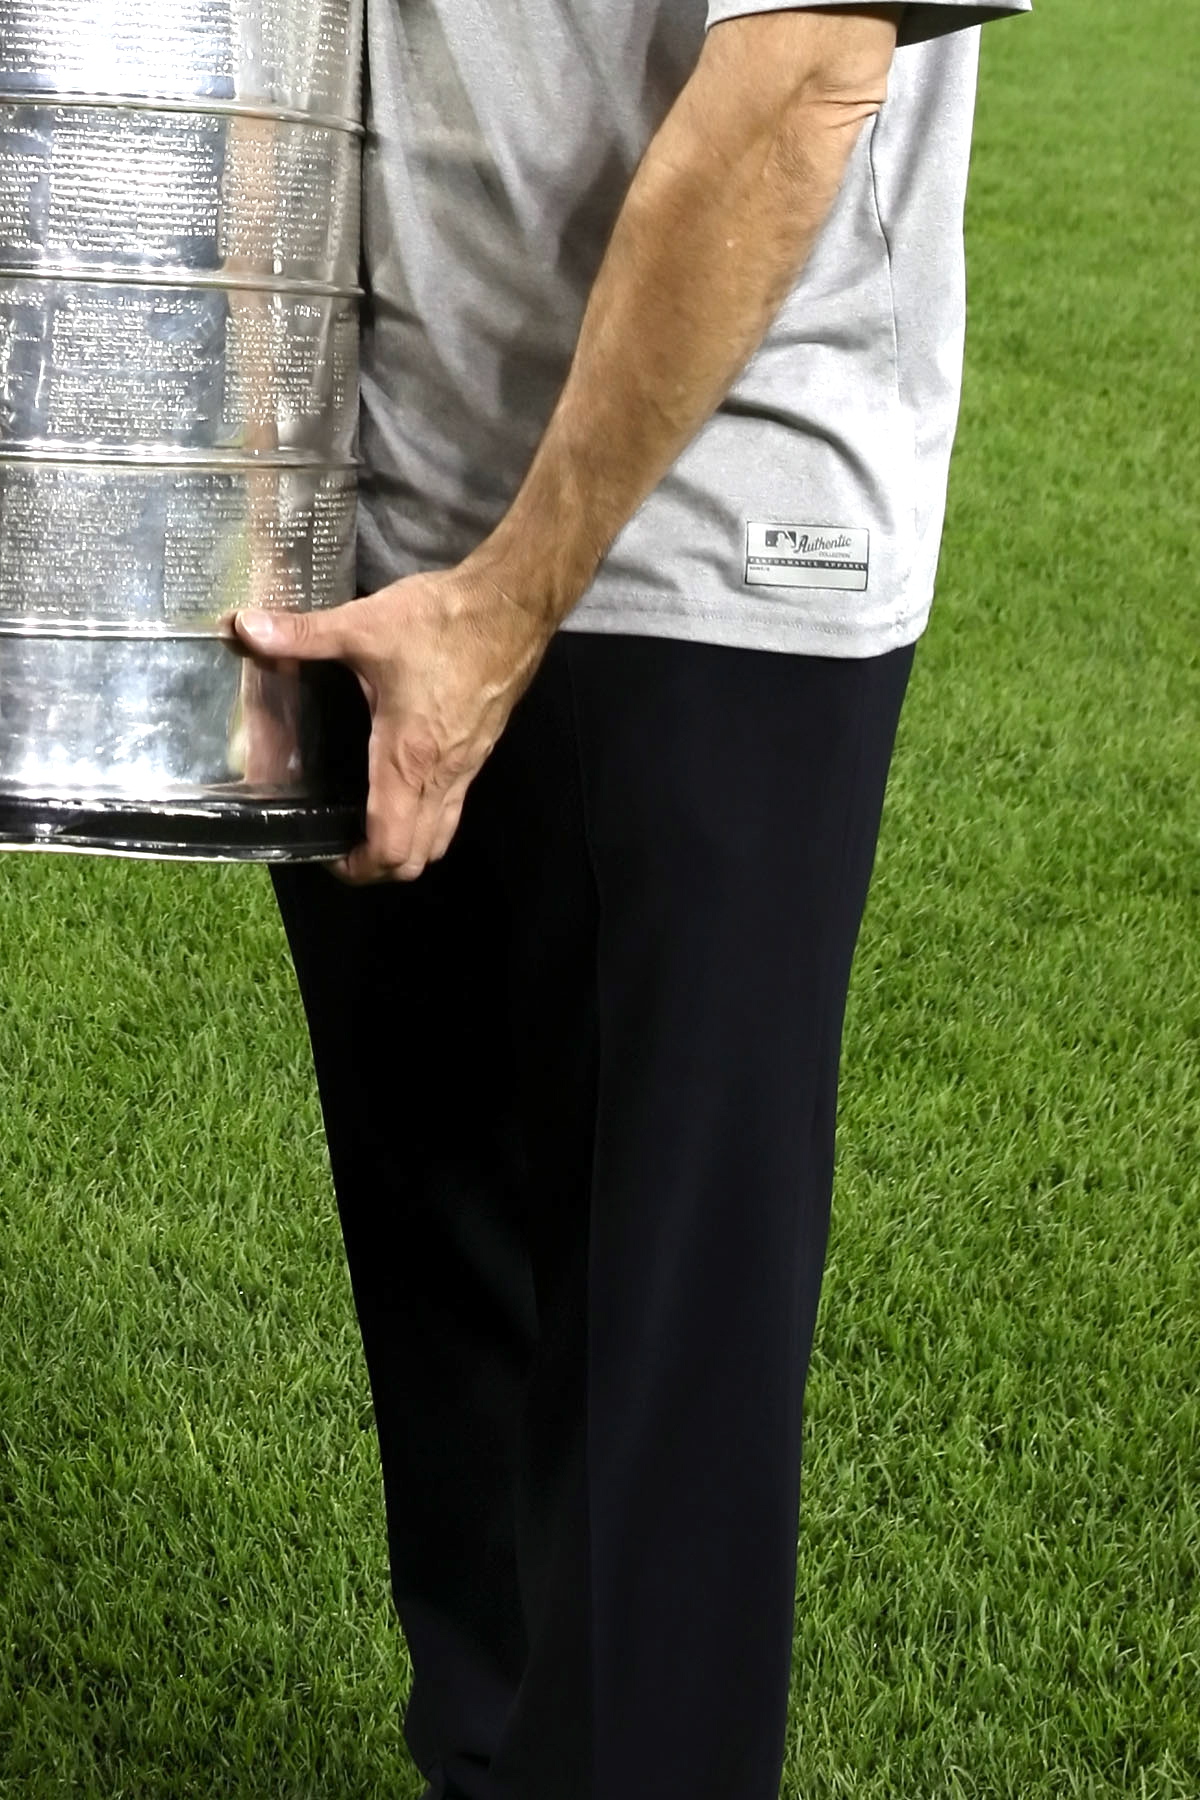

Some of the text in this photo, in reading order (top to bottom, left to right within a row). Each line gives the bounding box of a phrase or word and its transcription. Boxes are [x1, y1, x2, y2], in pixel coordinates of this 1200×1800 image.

[794, 534, 852, 554] Authentic
[819, 551, 851, 559] COLLECTION
[749, 557, 866, 572] PERFORMANCE APPAREL
